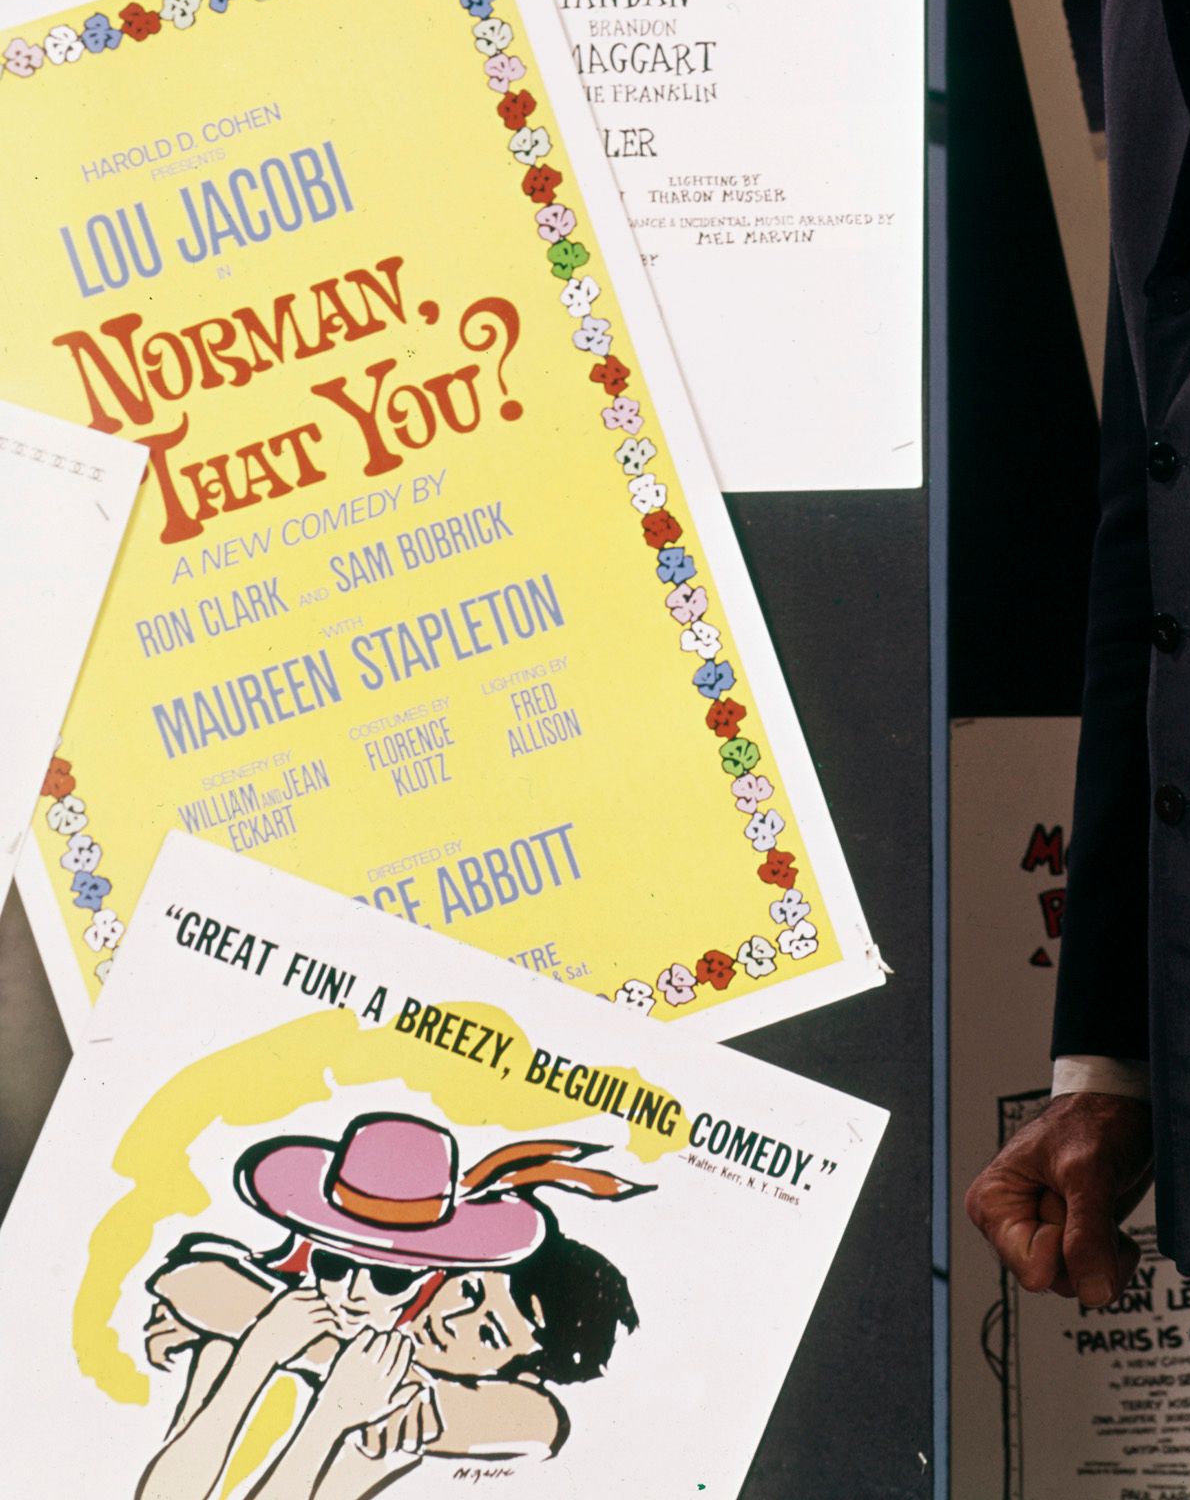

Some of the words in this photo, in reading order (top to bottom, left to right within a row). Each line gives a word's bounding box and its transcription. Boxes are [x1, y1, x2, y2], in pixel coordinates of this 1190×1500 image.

[588, 19, 678, 37] BRANDON
[612, 82, 718, 104] FRANKLIN
[80, 137, 174, 184] HAROLD
[178, 131, 199, 153] D.
[202, 102, 283, 145] COHEN
[150, 148, 227, 182] PRESENTS
[647, 188, 714, 203] THARON
[722, 187, 787, 203] MUSSER
[668, 174, 738, 187] LIGHTING
[742, 173, 762, 187] BY
[59, 201, 164, 299] LOU
[175, 140, 355, 265] JACOBI
[696, 231, 736, 245] MEL
[744, 229, 816, 245] MARVIN
[798, 213, 874, 227] ARRANGED
[216, 264, 233, 281] IN
[52, 256, 440, 435] NORMAN,
[311, 296, 524, 478] YOU?
[171, 556, 195, 585] A
[200, 528, 273, 577] NEW
[280, 484, 405, 548] COMEDY
[411, 469, 448, 505] BY
[135, 606, 197, 659] RON
[199, 576, 291, 638] CLARK
[329, 541, 396, 594] SAM
[396, 500, 515, 572] BOBRICK
[321, 615, 364, 640] WITH
[151, 649, 344, 761] MAUREEN
[350, 572, 566, 692] STAPLETON
[480, 661, 547, 697] LIGHTING
[546, 655, 570, 676] BY
[347, 701, 431, 742] COSTUMES
[430, 695, 452, 717] BY
[509, 681, 559, 722] FRED
[364, 716, 456, 773] FLORENCE
[506, 708, 583, 759] ALLISON
[200, 755, 271, 792] SCENERY
[272, 748, 294, 770] BY
[391, 752, 452, 798] KLOTZ
[177, 782, 263, 835] WILLIAM
[281, 758, 331, 802] JEAN
[227, 803, 298, 854] ECKART
[366, 844, 441, 883] DIRECTED
[442, 838, 465, 859] BY
[436, 822, 583, 925] ABBOTT
[165, 904, 279, 976] “GREAT
[282, 953, 358, 1010] FUN!
[361, 984, 387, 1023] A
[394, 998, 515, 1080] BREEZY,
[523, 1046, 683, 1139] BEGUILING
[688, 1111, 838, 1192] COMEDY.”
[720, 1163, 744, 1186] Kerr,
[773, 1186, 800, 1206] Times
[1158, 1325, 1183, 1349] IS
